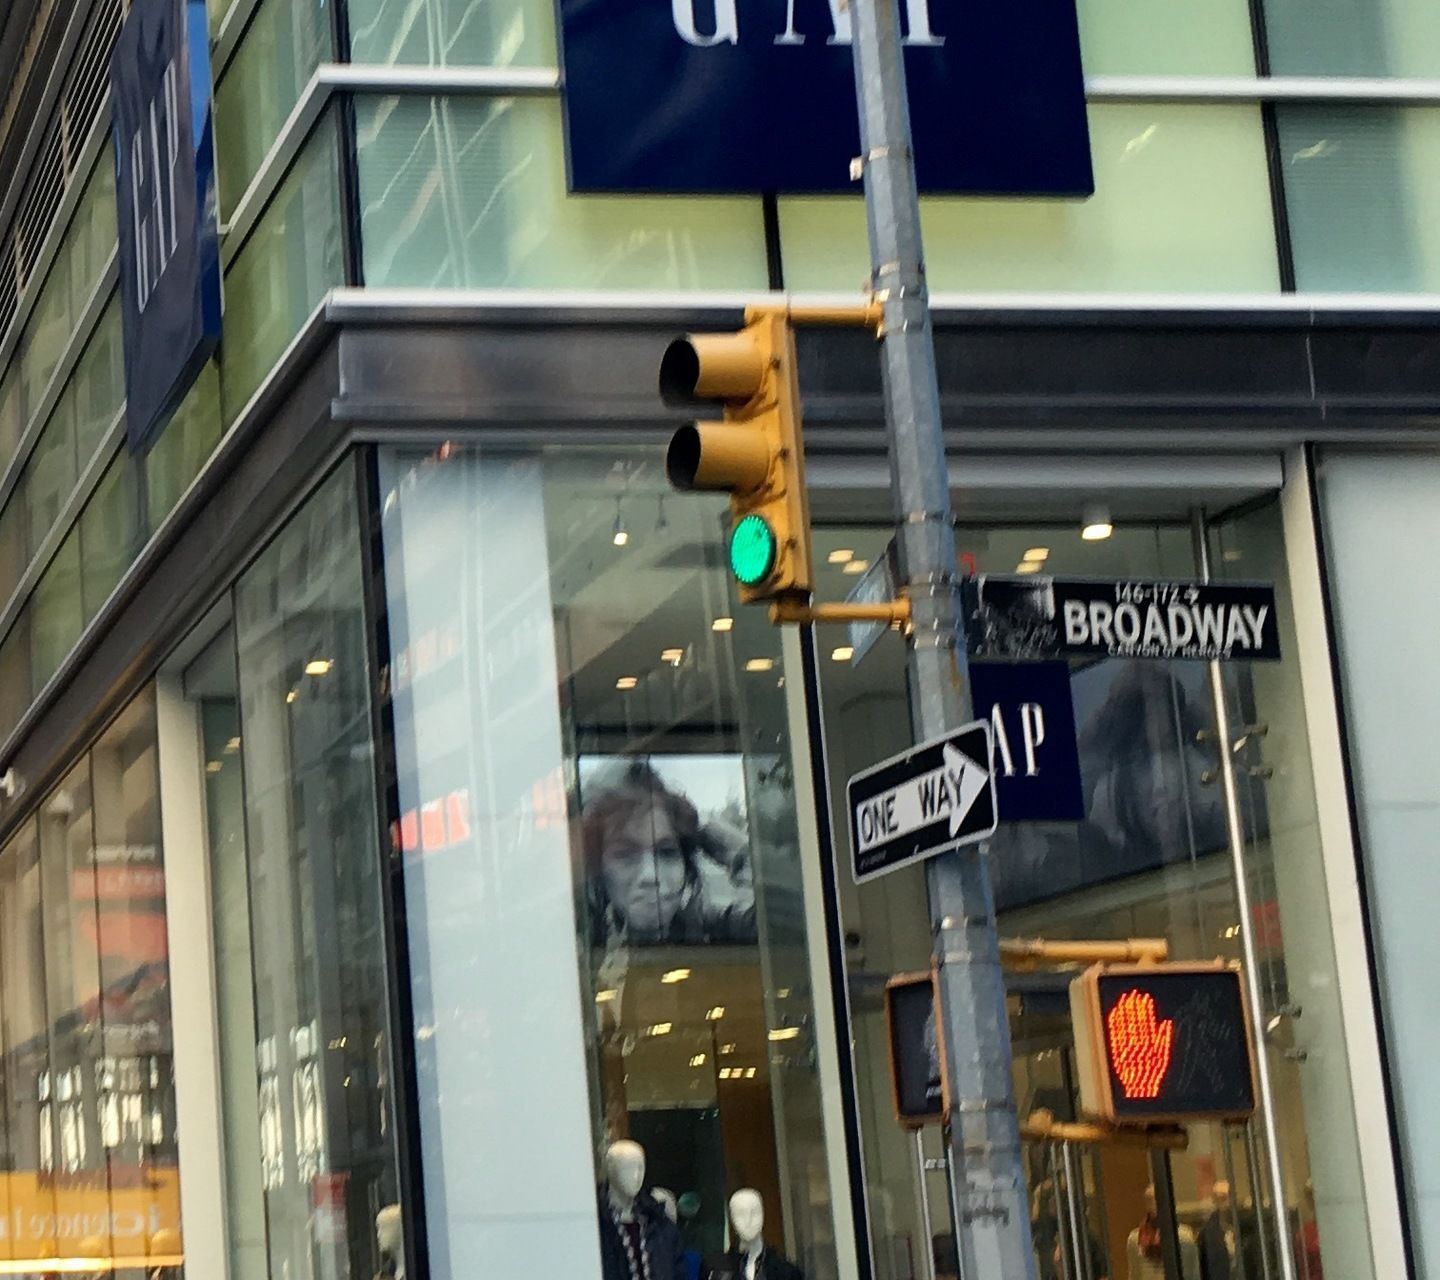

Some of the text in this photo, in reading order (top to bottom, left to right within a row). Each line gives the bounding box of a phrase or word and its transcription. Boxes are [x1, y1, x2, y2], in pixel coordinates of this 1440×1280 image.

[1063, 598, 1269, 652] BROADWAY
[990, 702, 1046, 777] AP
[861, 763, 966, 844] ONE WAY
